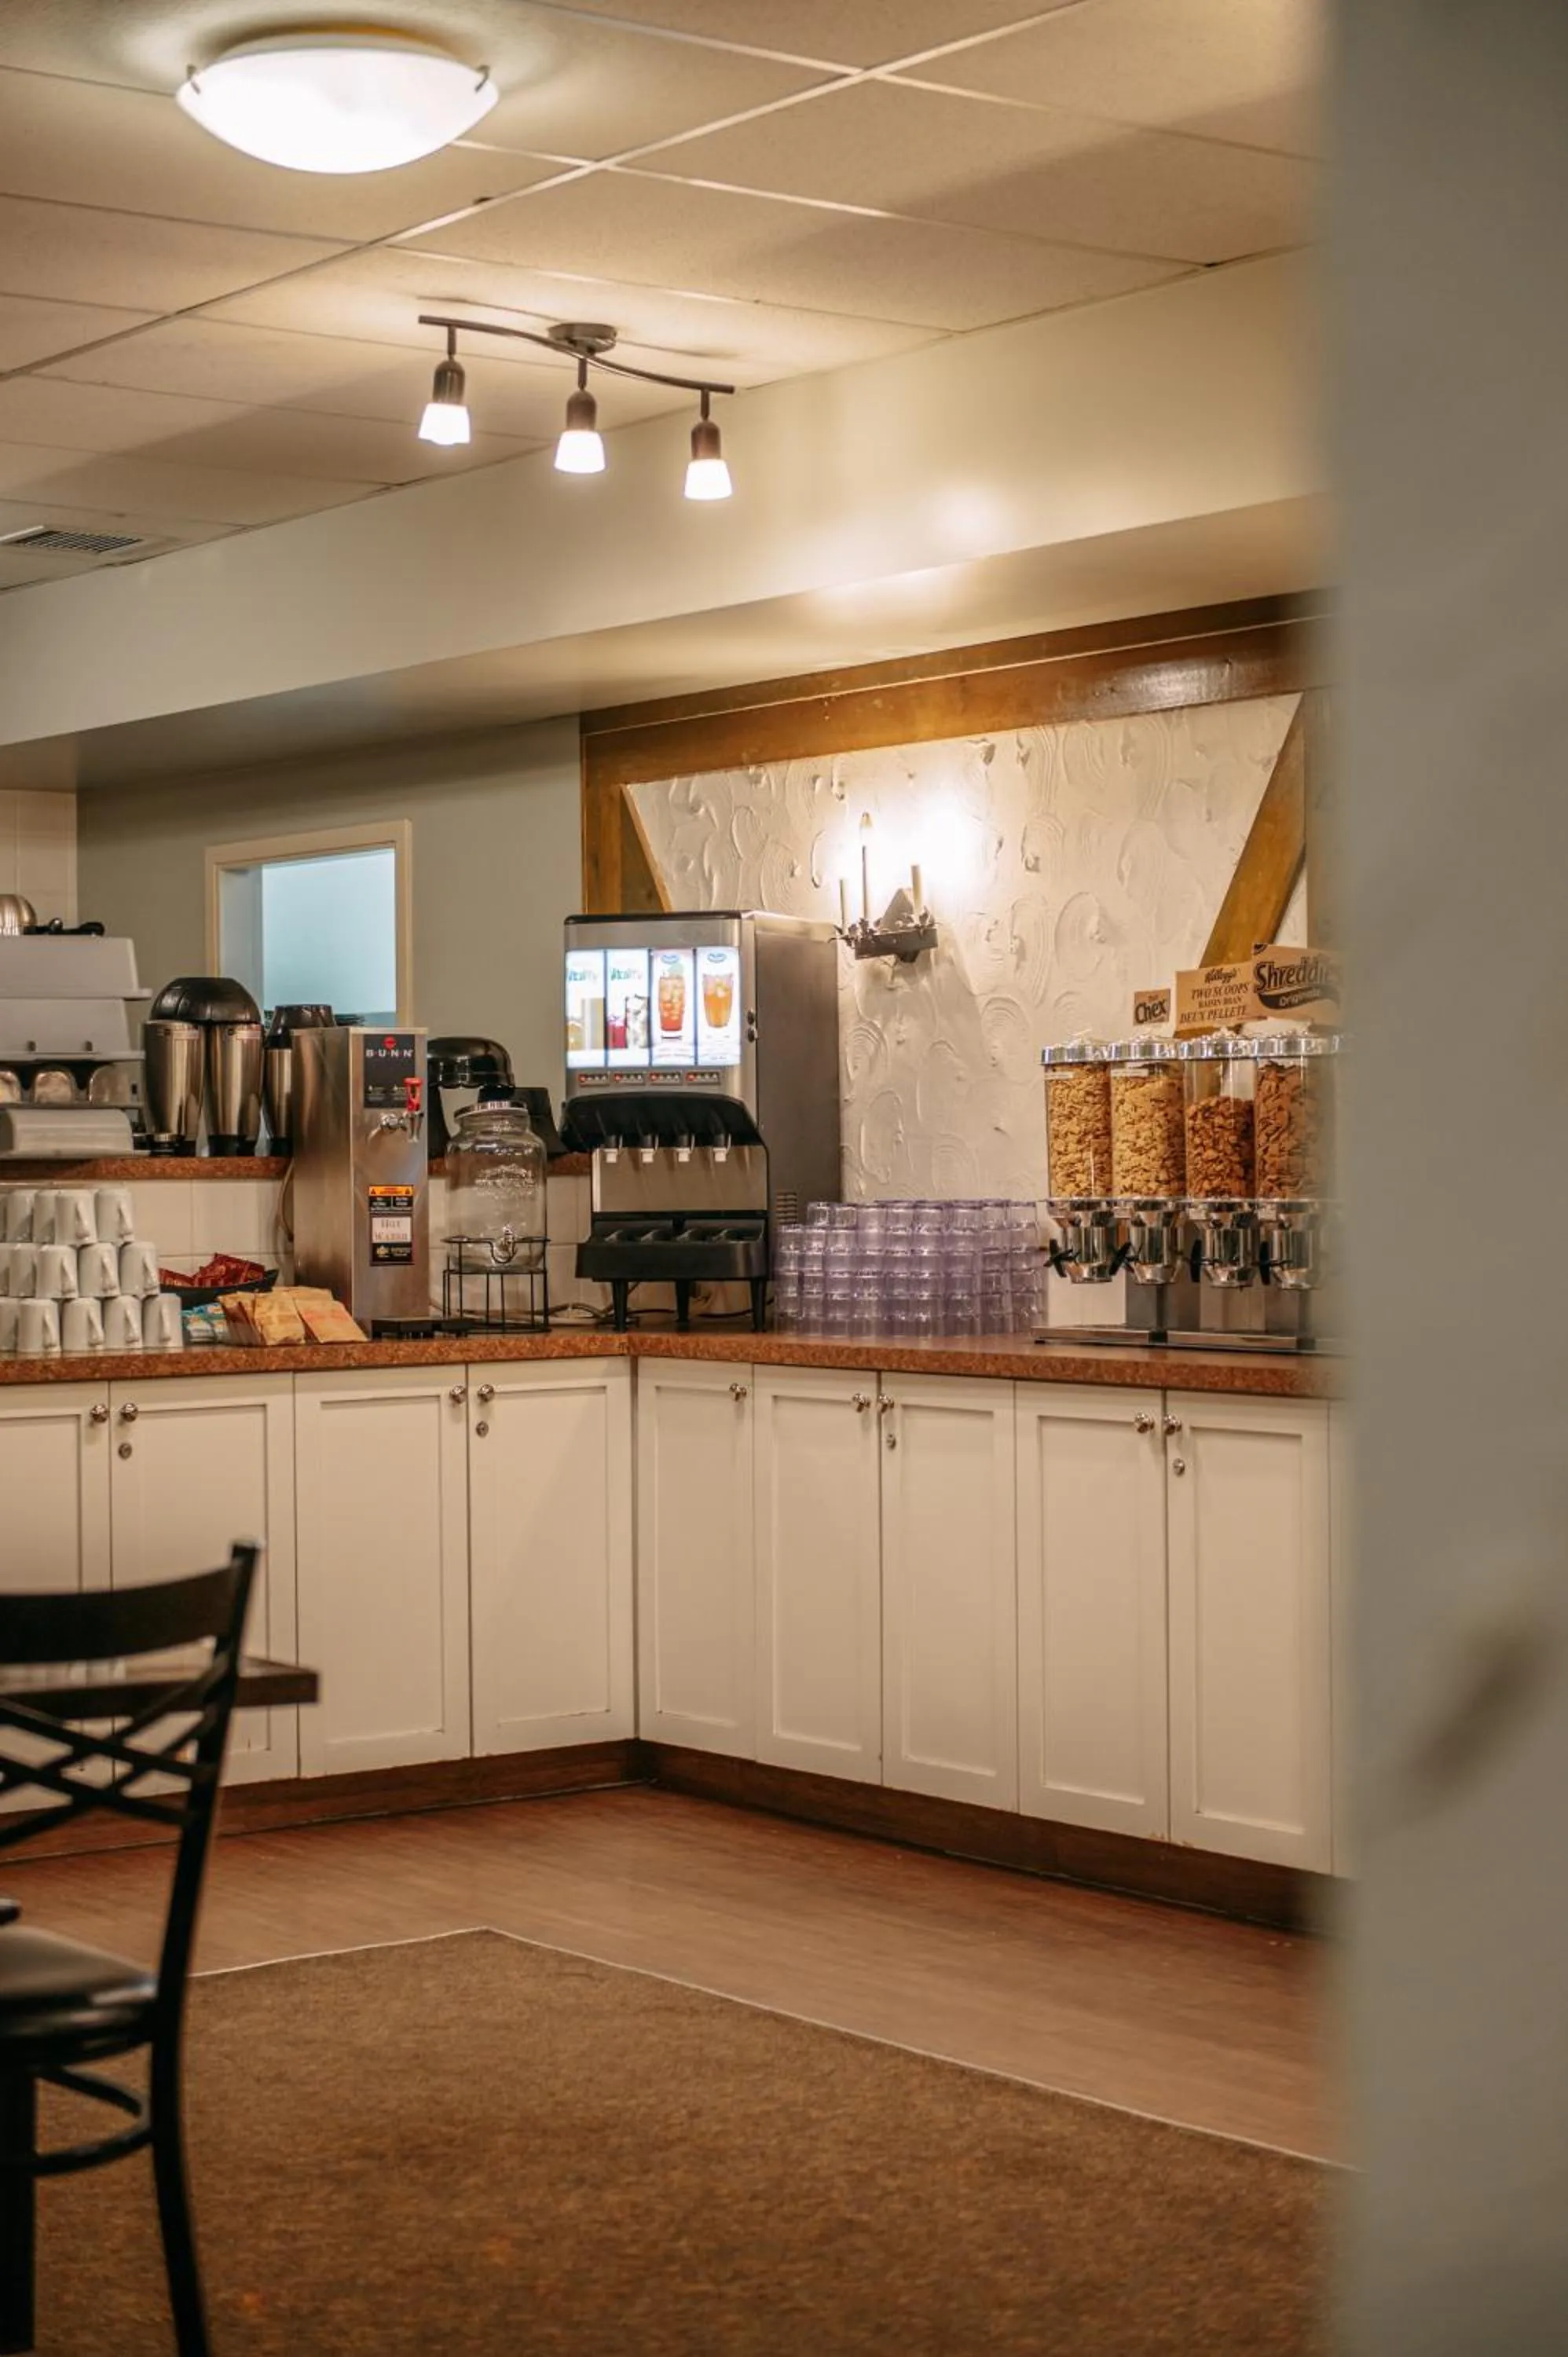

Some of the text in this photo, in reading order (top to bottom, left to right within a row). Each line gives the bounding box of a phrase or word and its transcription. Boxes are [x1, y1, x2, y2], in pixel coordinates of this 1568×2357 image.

[1252, 955, 1338, 993] Shreddie
[1192, 983, 1248, 1000] TWO SCOOPS
[1134, 998, 1167, 1024] Chex
